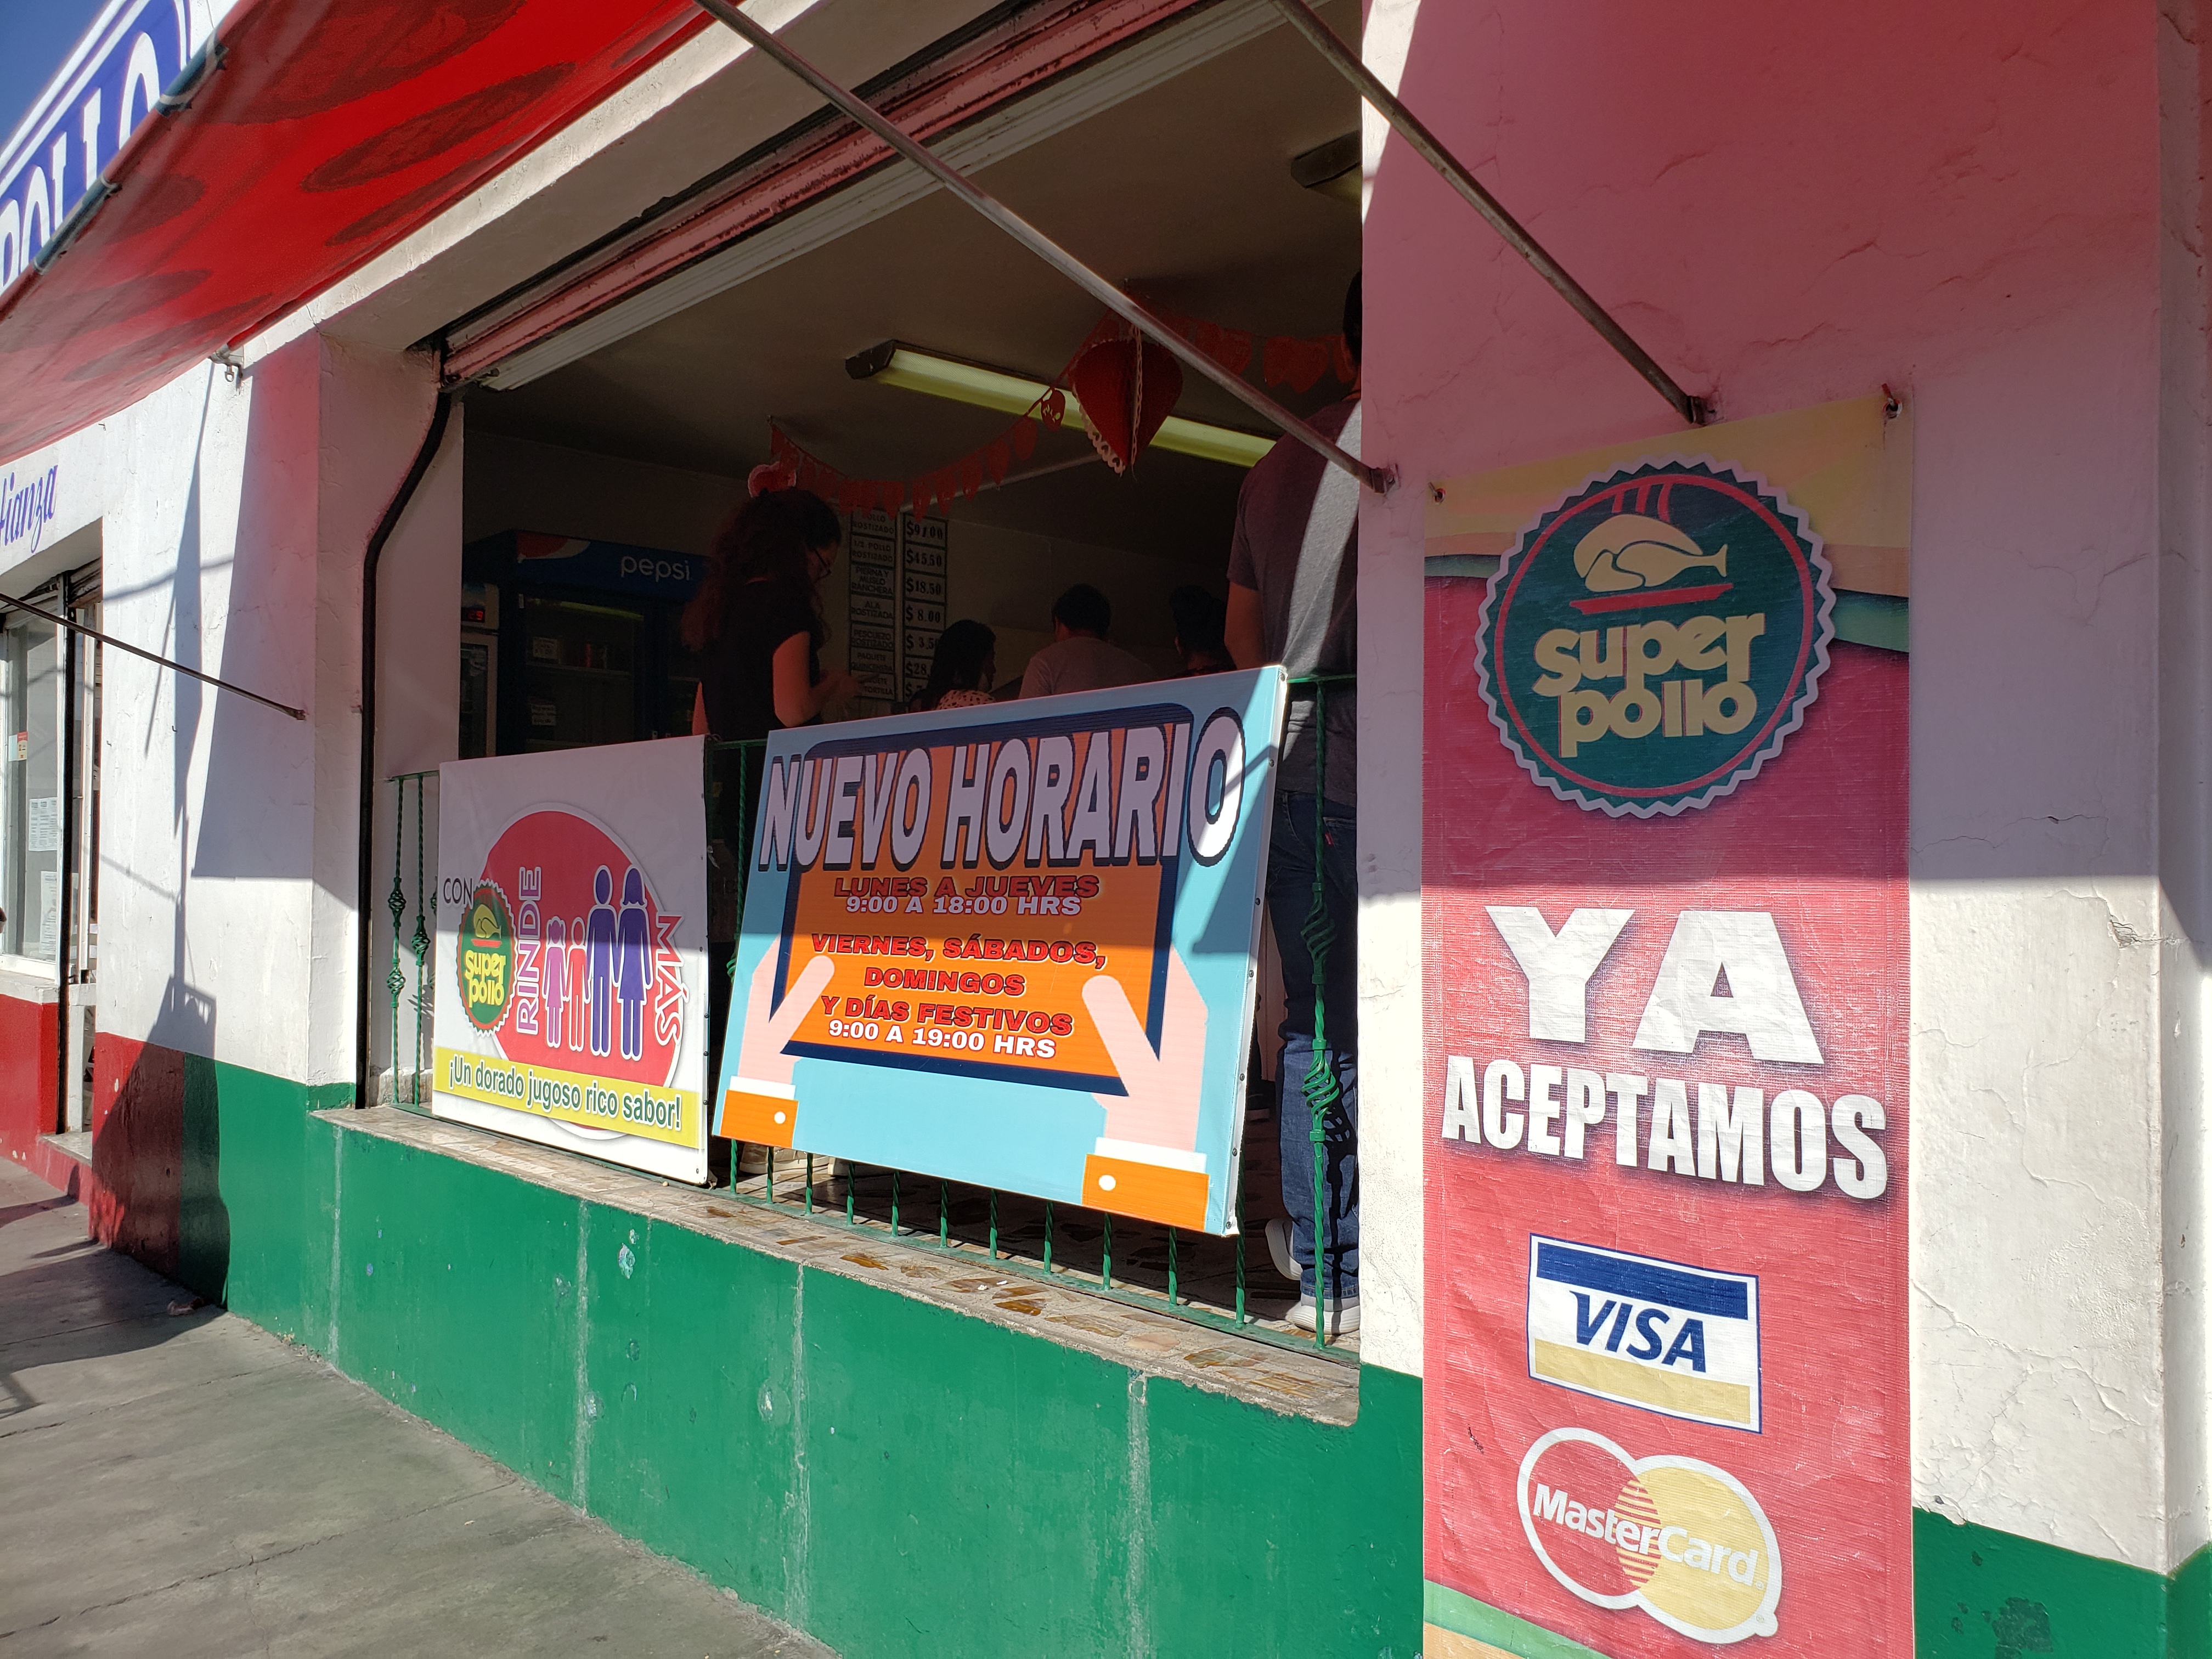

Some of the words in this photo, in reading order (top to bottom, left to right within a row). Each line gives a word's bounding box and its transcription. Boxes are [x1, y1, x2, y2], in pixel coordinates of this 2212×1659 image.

[621, 556, 690, 583] pepsi
[907, 577, 941, 595] $18.50
[906, 605, 913, 621] $
[918, 610, 940, 623] 8.00
[906, 634, 914, 650] $
[1532, 613, 1765, 696] super
[1558, 679, 1757, 758] pollo
[758, 748, 932, 871] NUEVO
[940, 707, 1246, 868] HORARIO
[443, 878, 472, 909] CON
[834, 878, 927, 898] LUNES
[935, 877, 957, 898] A
[966, 876, 1099, 898] JUEVES
[847, 896, 898, 913] 9:00
[905, 896, 923, 913] A
[933, 896, 1007, 915] 18:00
[1017, 896, 1081, 915] HRS
[465, 950, 506, 984] super
[517, 867, 540, 1034] RINDE
[812, 933, 934, 961] VIERNES,
[943, 934, 1106, 969] SÁBADOS,
[469, 978, 504, 1008] pollo
[657, 912, 689, 1045] MÁS
[864, 967, 1025, 996] DOMINGOS
[1484, 905, 1824, 1064] YA
[821, 996, 839, 1015] Y
[845, 995, 909, 1022] DÍAS
[918, 1003, 1073, 1036] FESTIVOS
[829, 1019, 878, 1040] 9:00
[885, 1025, 904, 1043] A
[912, 1028, 984, 1051] 19:00
[994, 1035, 1056, 1059] HRS
[450, 1055, 471, 1088] ¡Un
[476, 1061, 524, 1097] dorado
[527, 1071, 580, 1110] jugoso
[586, 1082, 618, 1115] rico
[623, 1091, 681, 1128] sabor!
[1441, 1055, 1887, 1199] ACEPTAMOS
[1570, 1289, 1706, 1373] VISA
[1533, 1483, 1763, 1586] MasterCard
